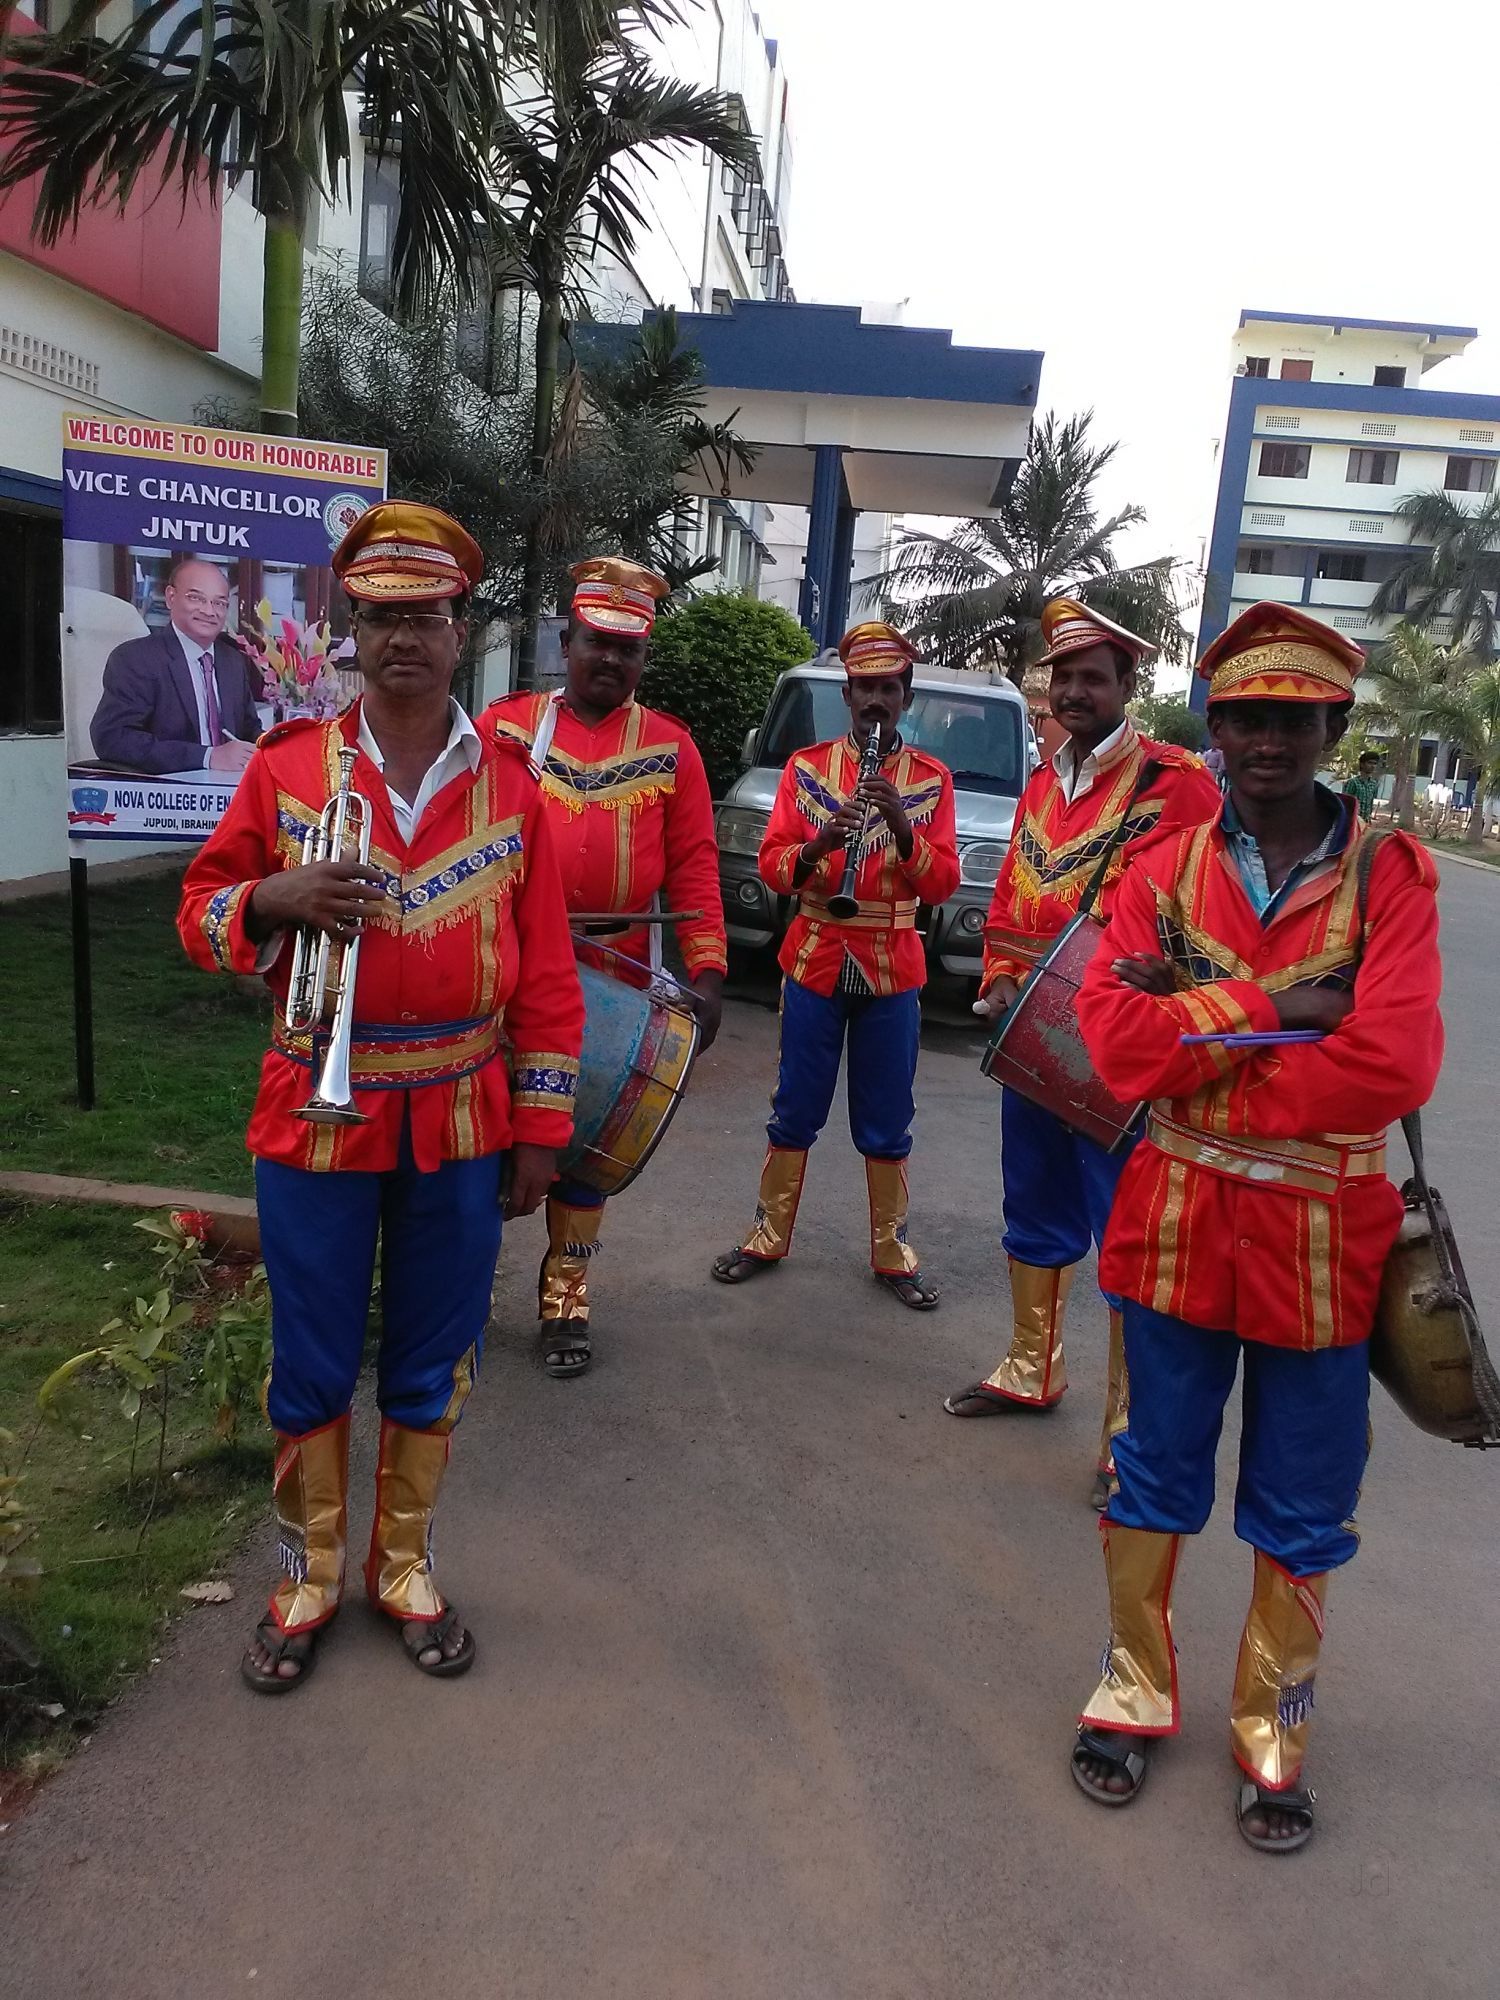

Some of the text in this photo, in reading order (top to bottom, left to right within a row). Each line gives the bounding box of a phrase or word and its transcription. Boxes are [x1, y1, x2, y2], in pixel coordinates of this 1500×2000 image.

[68, 419, 377, 478] WELCOME TO OUR HONORABLE
[66, 469, 322, 519] VICE CHANCELLOR
[141, 516, 250, 548] JNTUK
[114, 790, 145, 809] NOVA
[148, 793, 197, 811] COLLEGE
[199, 794, 213, 812] OF
[143, 817, 221, 831] JUPUDI, IBRAHIM
